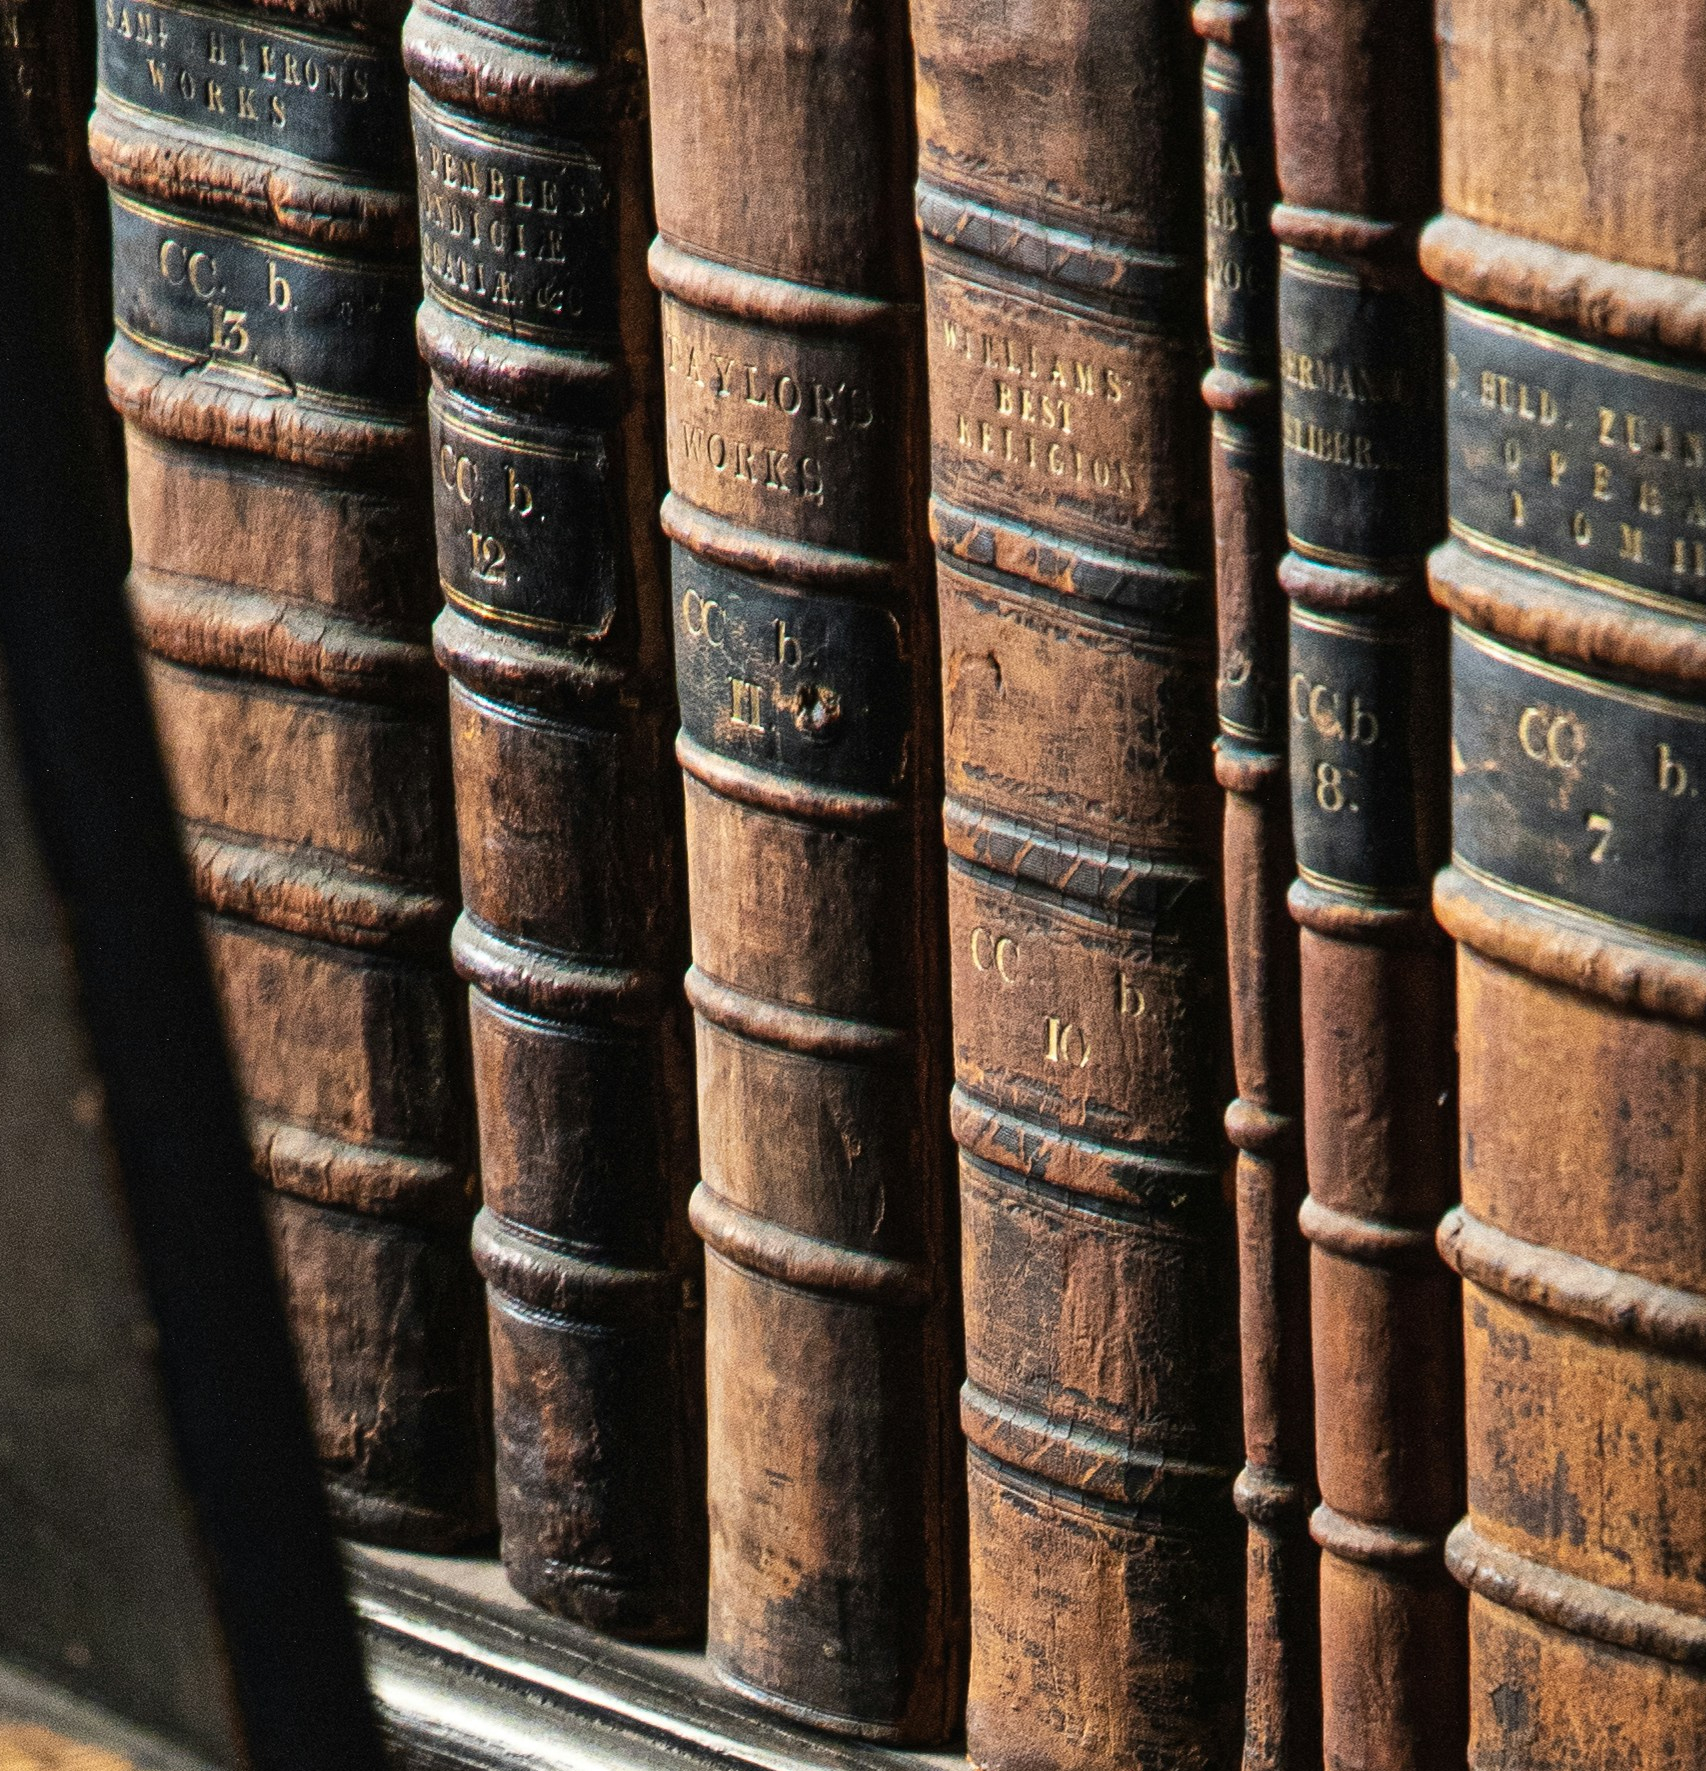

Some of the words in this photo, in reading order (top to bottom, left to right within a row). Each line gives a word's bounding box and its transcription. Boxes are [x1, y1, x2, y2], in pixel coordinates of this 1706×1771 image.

[146, 57, 287, 129] WORKS
[998, 379, 1072, 434] BEST
[682, 421, 825, 499] WORKS
